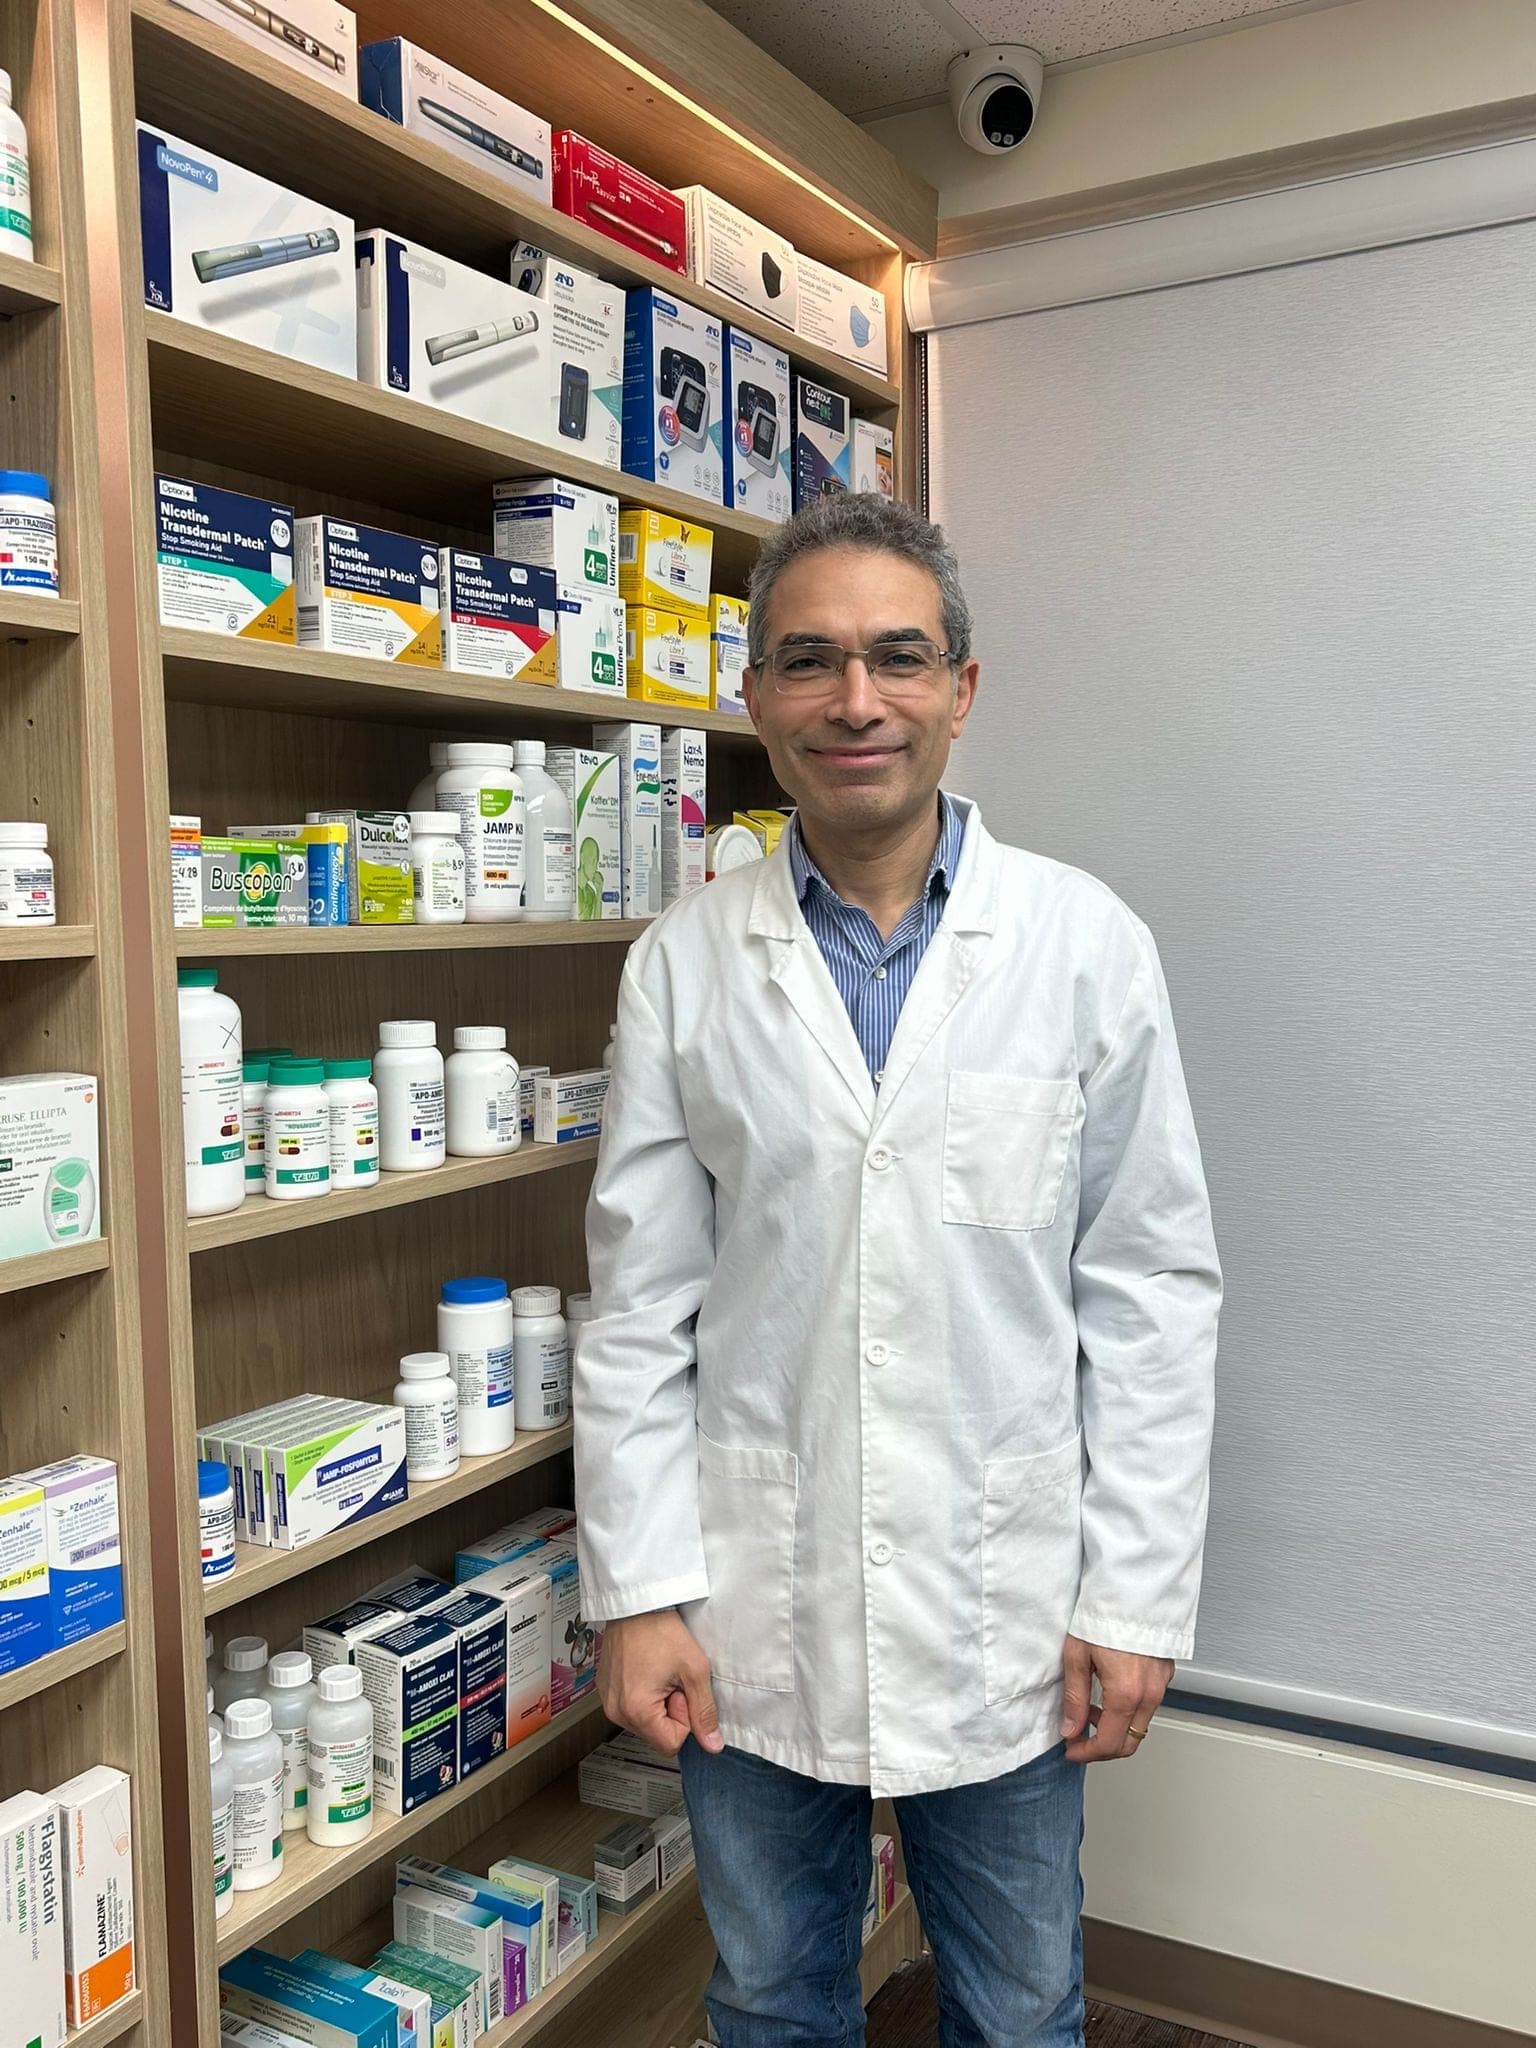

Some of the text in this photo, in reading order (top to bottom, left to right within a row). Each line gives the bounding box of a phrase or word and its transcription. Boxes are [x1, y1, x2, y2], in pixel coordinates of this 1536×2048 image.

[161, 152, 202, 179] NovoPen
[806, 385, 832, 405] Contour
[160, 502, 209, 524] Nicotine
[160, 517, 230, 545] Transdermal
[161, 532, 222, 552] Stop Smoking Aid
[329, 542, 369, 562] Nicotine
[24, 555, 38, 564] 150
[162, 555, 181, 565] STEP
[329, 555, 388, 579] Transdermal
[586, 554, 596, 577] 4
[330, 569, 344, 580] Stop
[345, 573, 370, 586] Smoking
[455, 572, 492, 588] Nicotine
[455, 584, 508, 604] Transdermal
[456, 597, 502, 611] Stop Smoking Aid
[267, 614, 276, 624] 21
[593, 656, 604, 679] 4
[580, 751, 599, 766] teva
[684, 756, 705, 768] Nema
[636, 769, 659, 783] Ene-med
[361, 826, 408, 844] Dulcol
[483, 822, 514, 835] JAMP
[211, 866, 292, 898] Buscopan
[331, 855, 340, 922] Contingency
[296, 915, 307, 924] mg
[0, 1107, 67, 1125] RUSE ELLIPTA
[321, 1452, 379, 1482] JAMP-FOSFOMYCIN
[74, 1495, 105, 1512] Zenhale
[72, 1550, 85, 1562] 200
[85, 1547, 97, 1558] mcg
[105, 1539, 118, 1548] mcg
[9, 1573, 22, 1589] mcg
[32, 1565, 45, 1579] mcg
[16, 1830, 25, 1851] 500
[15, 1853, 24, 1871] mg
[39, 1820, 58, 1925] Flagystatin
[17, 1877, 27, 1920] 100,000
[97, 1894, 106, 1958] FLAMAZINE
